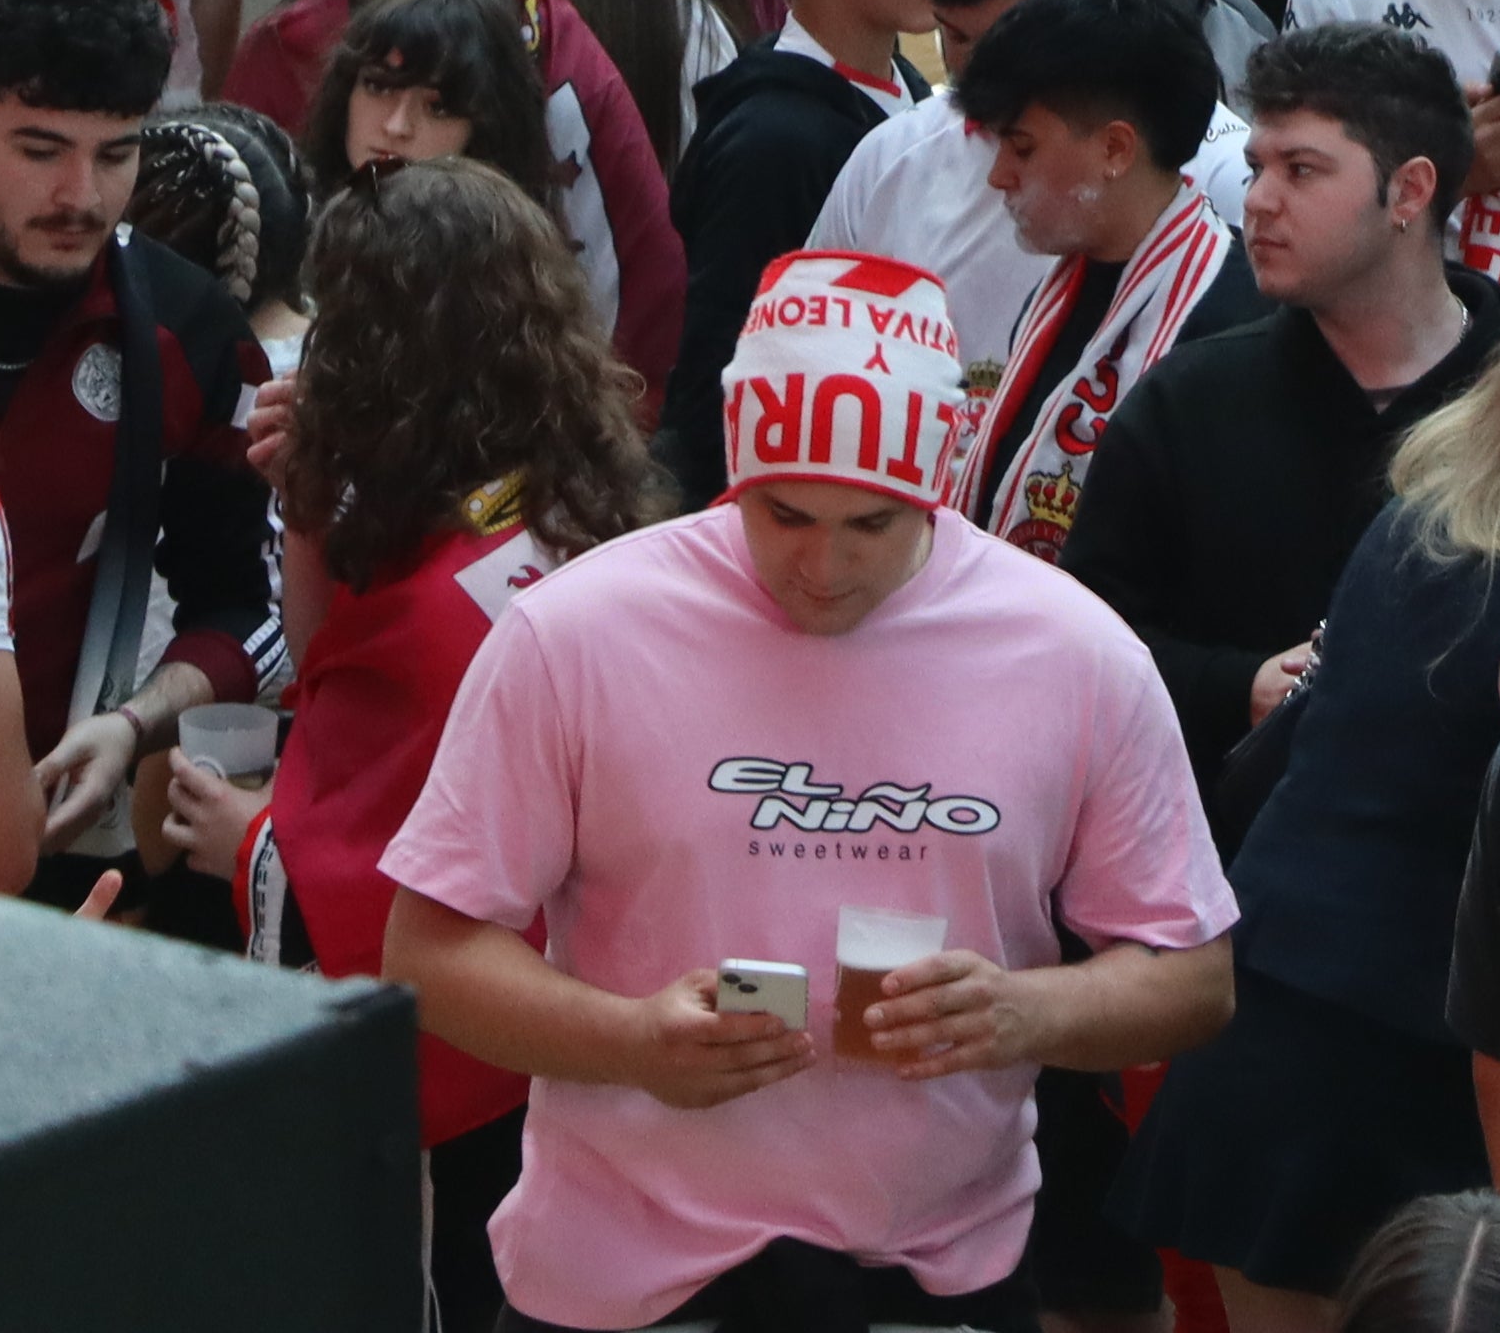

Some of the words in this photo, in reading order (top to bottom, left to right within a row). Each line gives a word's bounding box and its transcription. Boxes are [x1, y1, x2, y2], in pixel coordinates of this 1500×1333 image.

[864, 342, 891, 376] Y
[707, 756, 845, 796] EL
[748, 840, 932, 864] sweetwear
